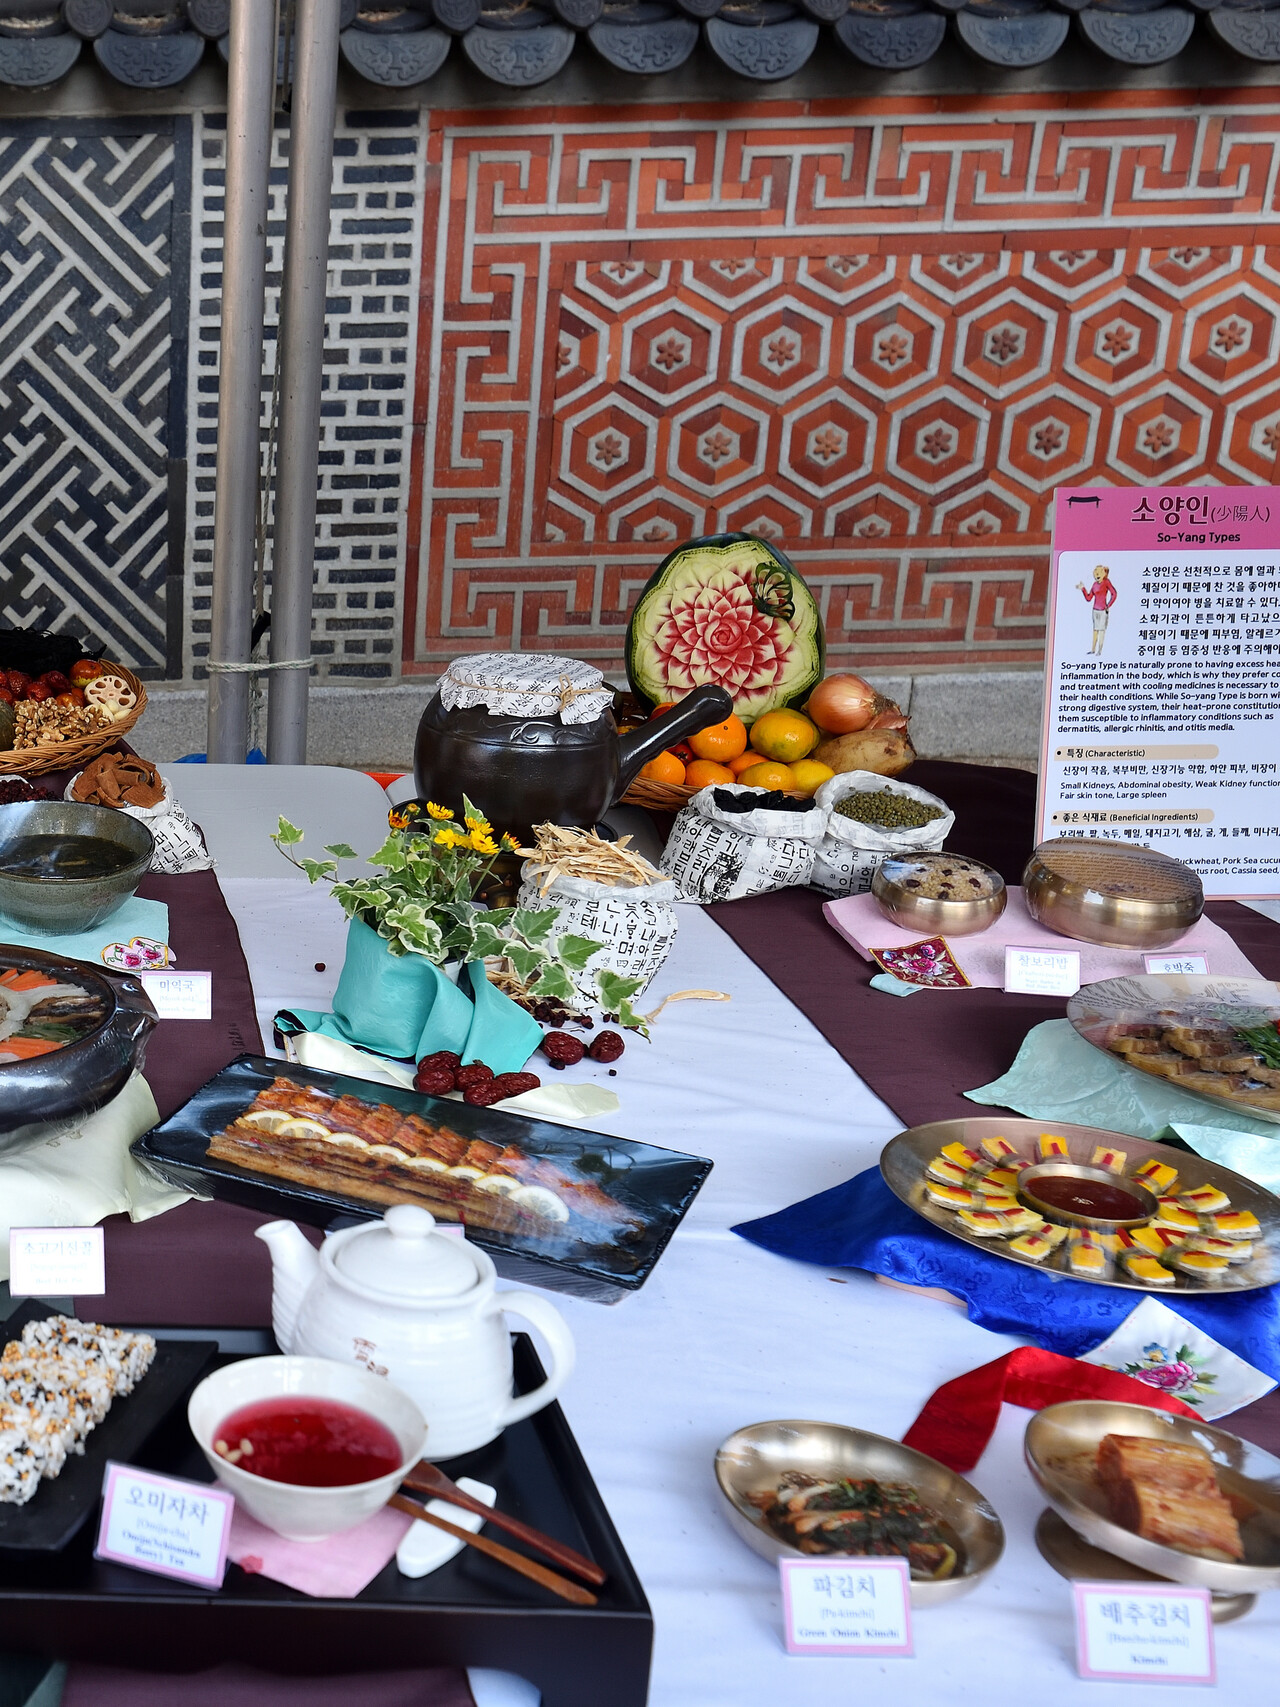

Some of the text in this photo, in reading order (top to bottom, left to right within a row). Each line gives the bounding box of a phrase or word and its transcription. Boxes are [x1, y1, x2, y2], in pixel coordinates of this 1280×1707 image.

[1131, 495, 1271, 526] 소양인(少陽人)
[1157, 531, 1240, 543] So-Yang Types
[1142, 565, 1275, 577] 소양인은 선천적으로 몸에 열과
[1060, 661, 1096, 670] So-yang
[1098, 661, 1118, 670] Type
[1119, 661, 1126, 669] is
[1128, 660, 1165, 669] naturally
[1205, 660, 1234, 669] having
[1265, 659, 1280, 667] hea
[1077, 682, 1120, 690] treatment
[1142, 682, 1173, 690] cooling
[1174, 681, 1216, 689] medicines
[1217, 681, 1224, 689] is
[1058, 714, 1079, 722] them
[1081, 713, 1128, 722] susceptible
[1140, 713, 1196, 721] inflammatory
[1197, 712, 1241, 720] conditions
[1242, 712, 1262, 720] such
[1057, 723, 1235, 733] dermatitis, allergic rhinitis, and otitis media.
[1085, 749, 1145, 758] (Characteristic)
[1059, 791, 1075, 799] Fair
[1076, 791, 1092, 799] skin
[1116, 791, 1139, 799] Large
[1141, 790, 1167, 799] spleen
[1082, 812, 1106, 822] 식재료
[1109, 813, 1150, 822] (Beneficial
[125, 1486, 210, 1527] 오미자차
[813, 1574, 876, 1599] 파김치
[1099, 1600, 1191, 1629] 배추김치
